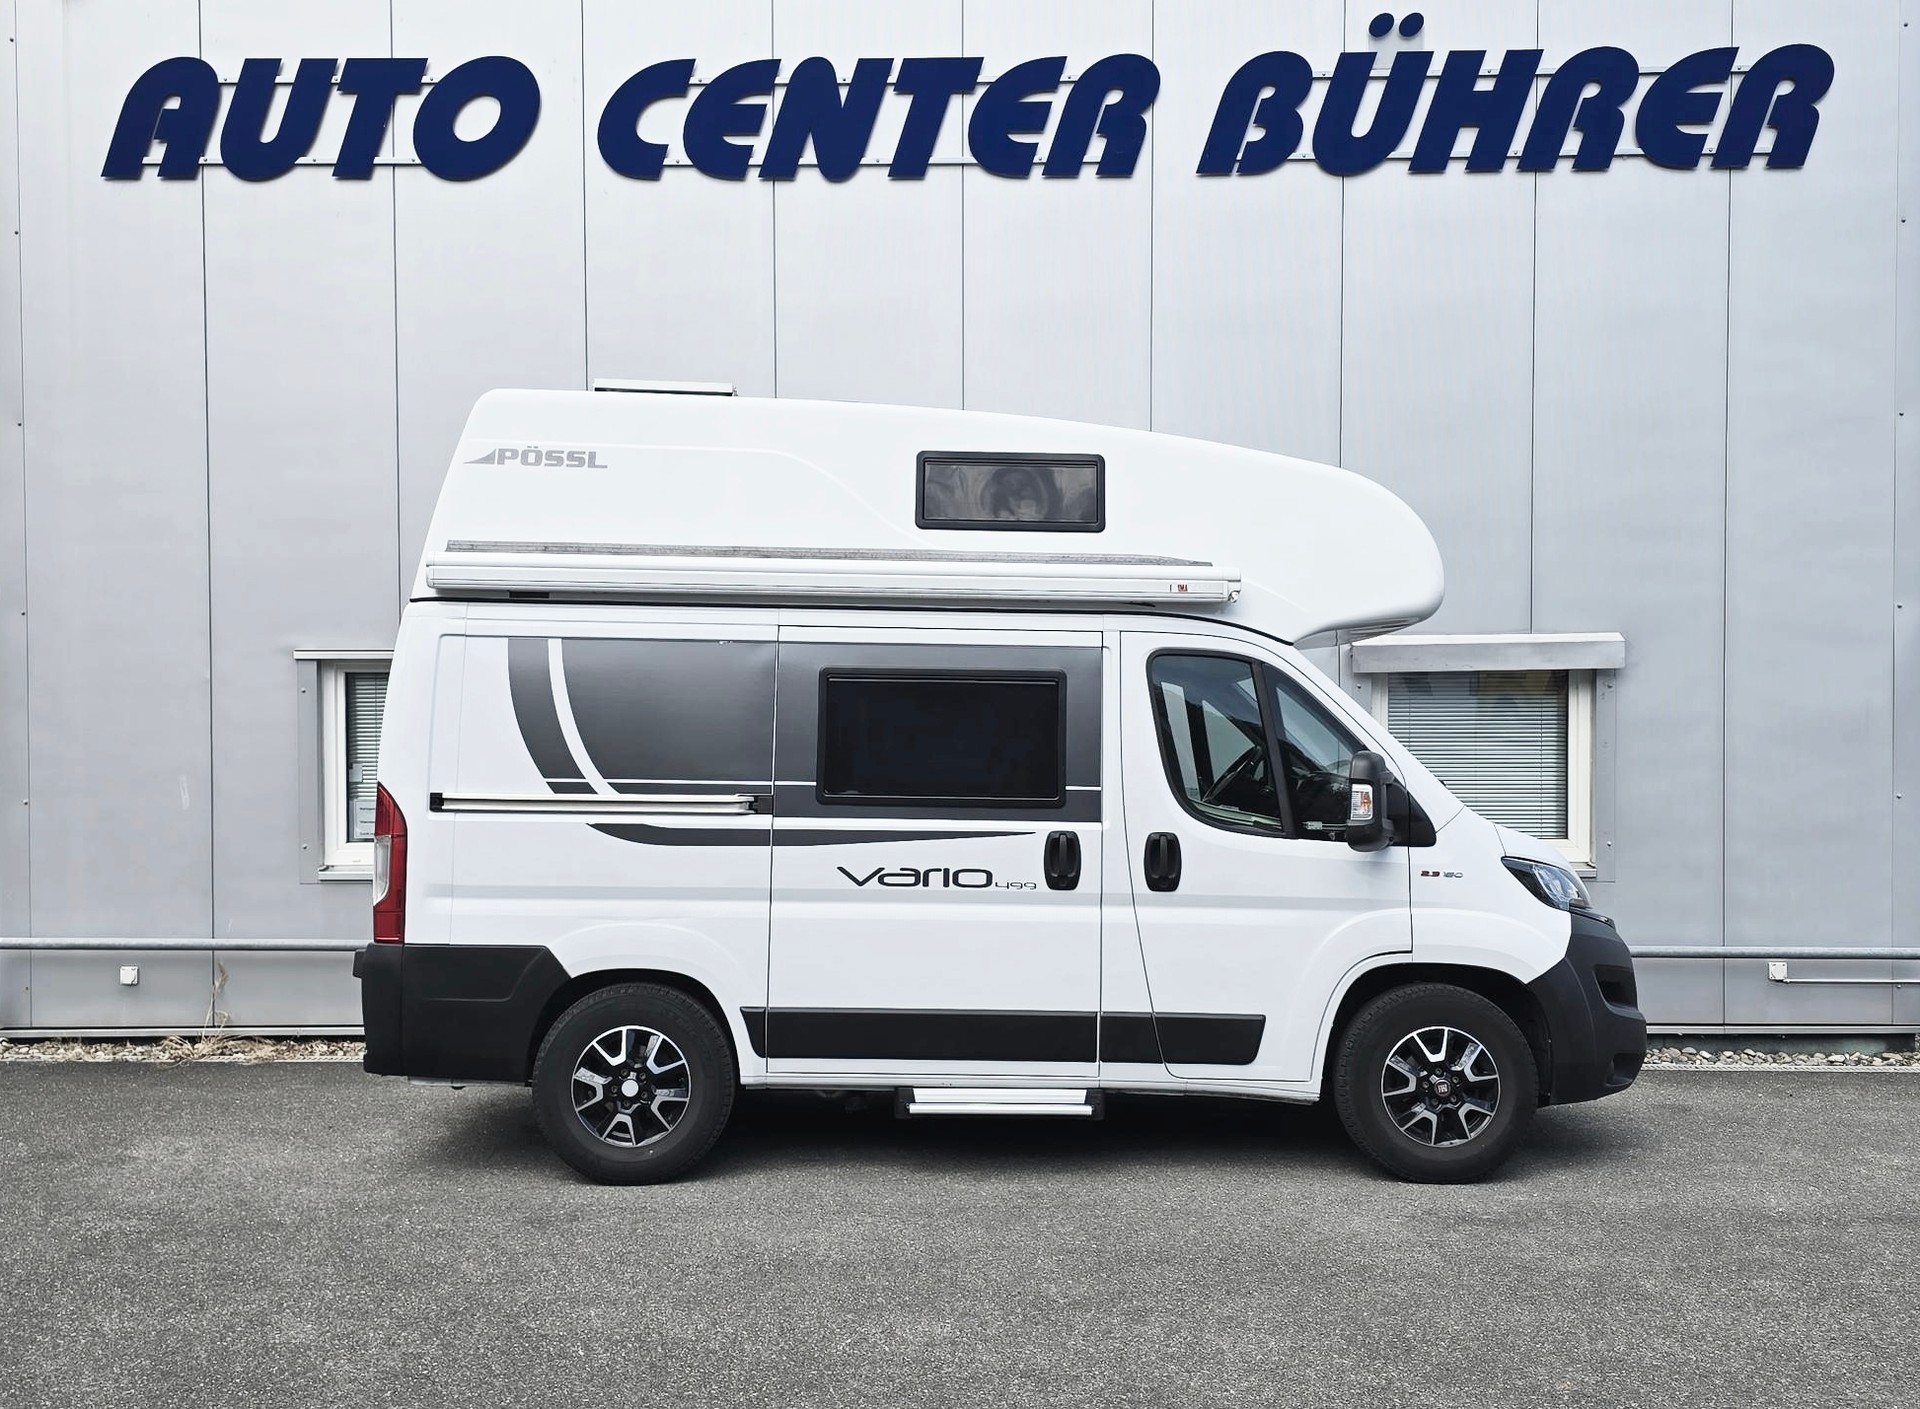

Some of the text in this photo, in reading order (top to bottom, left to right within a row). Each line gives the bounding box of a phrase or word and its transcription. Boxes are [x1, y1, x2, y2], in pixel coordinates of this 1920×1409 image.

[101, 12, 1836, 182] AUTO CENTER BÜHRER
[496, 445, 608, 469] PÖSSL
[994, 881, 1037, 890] 499
